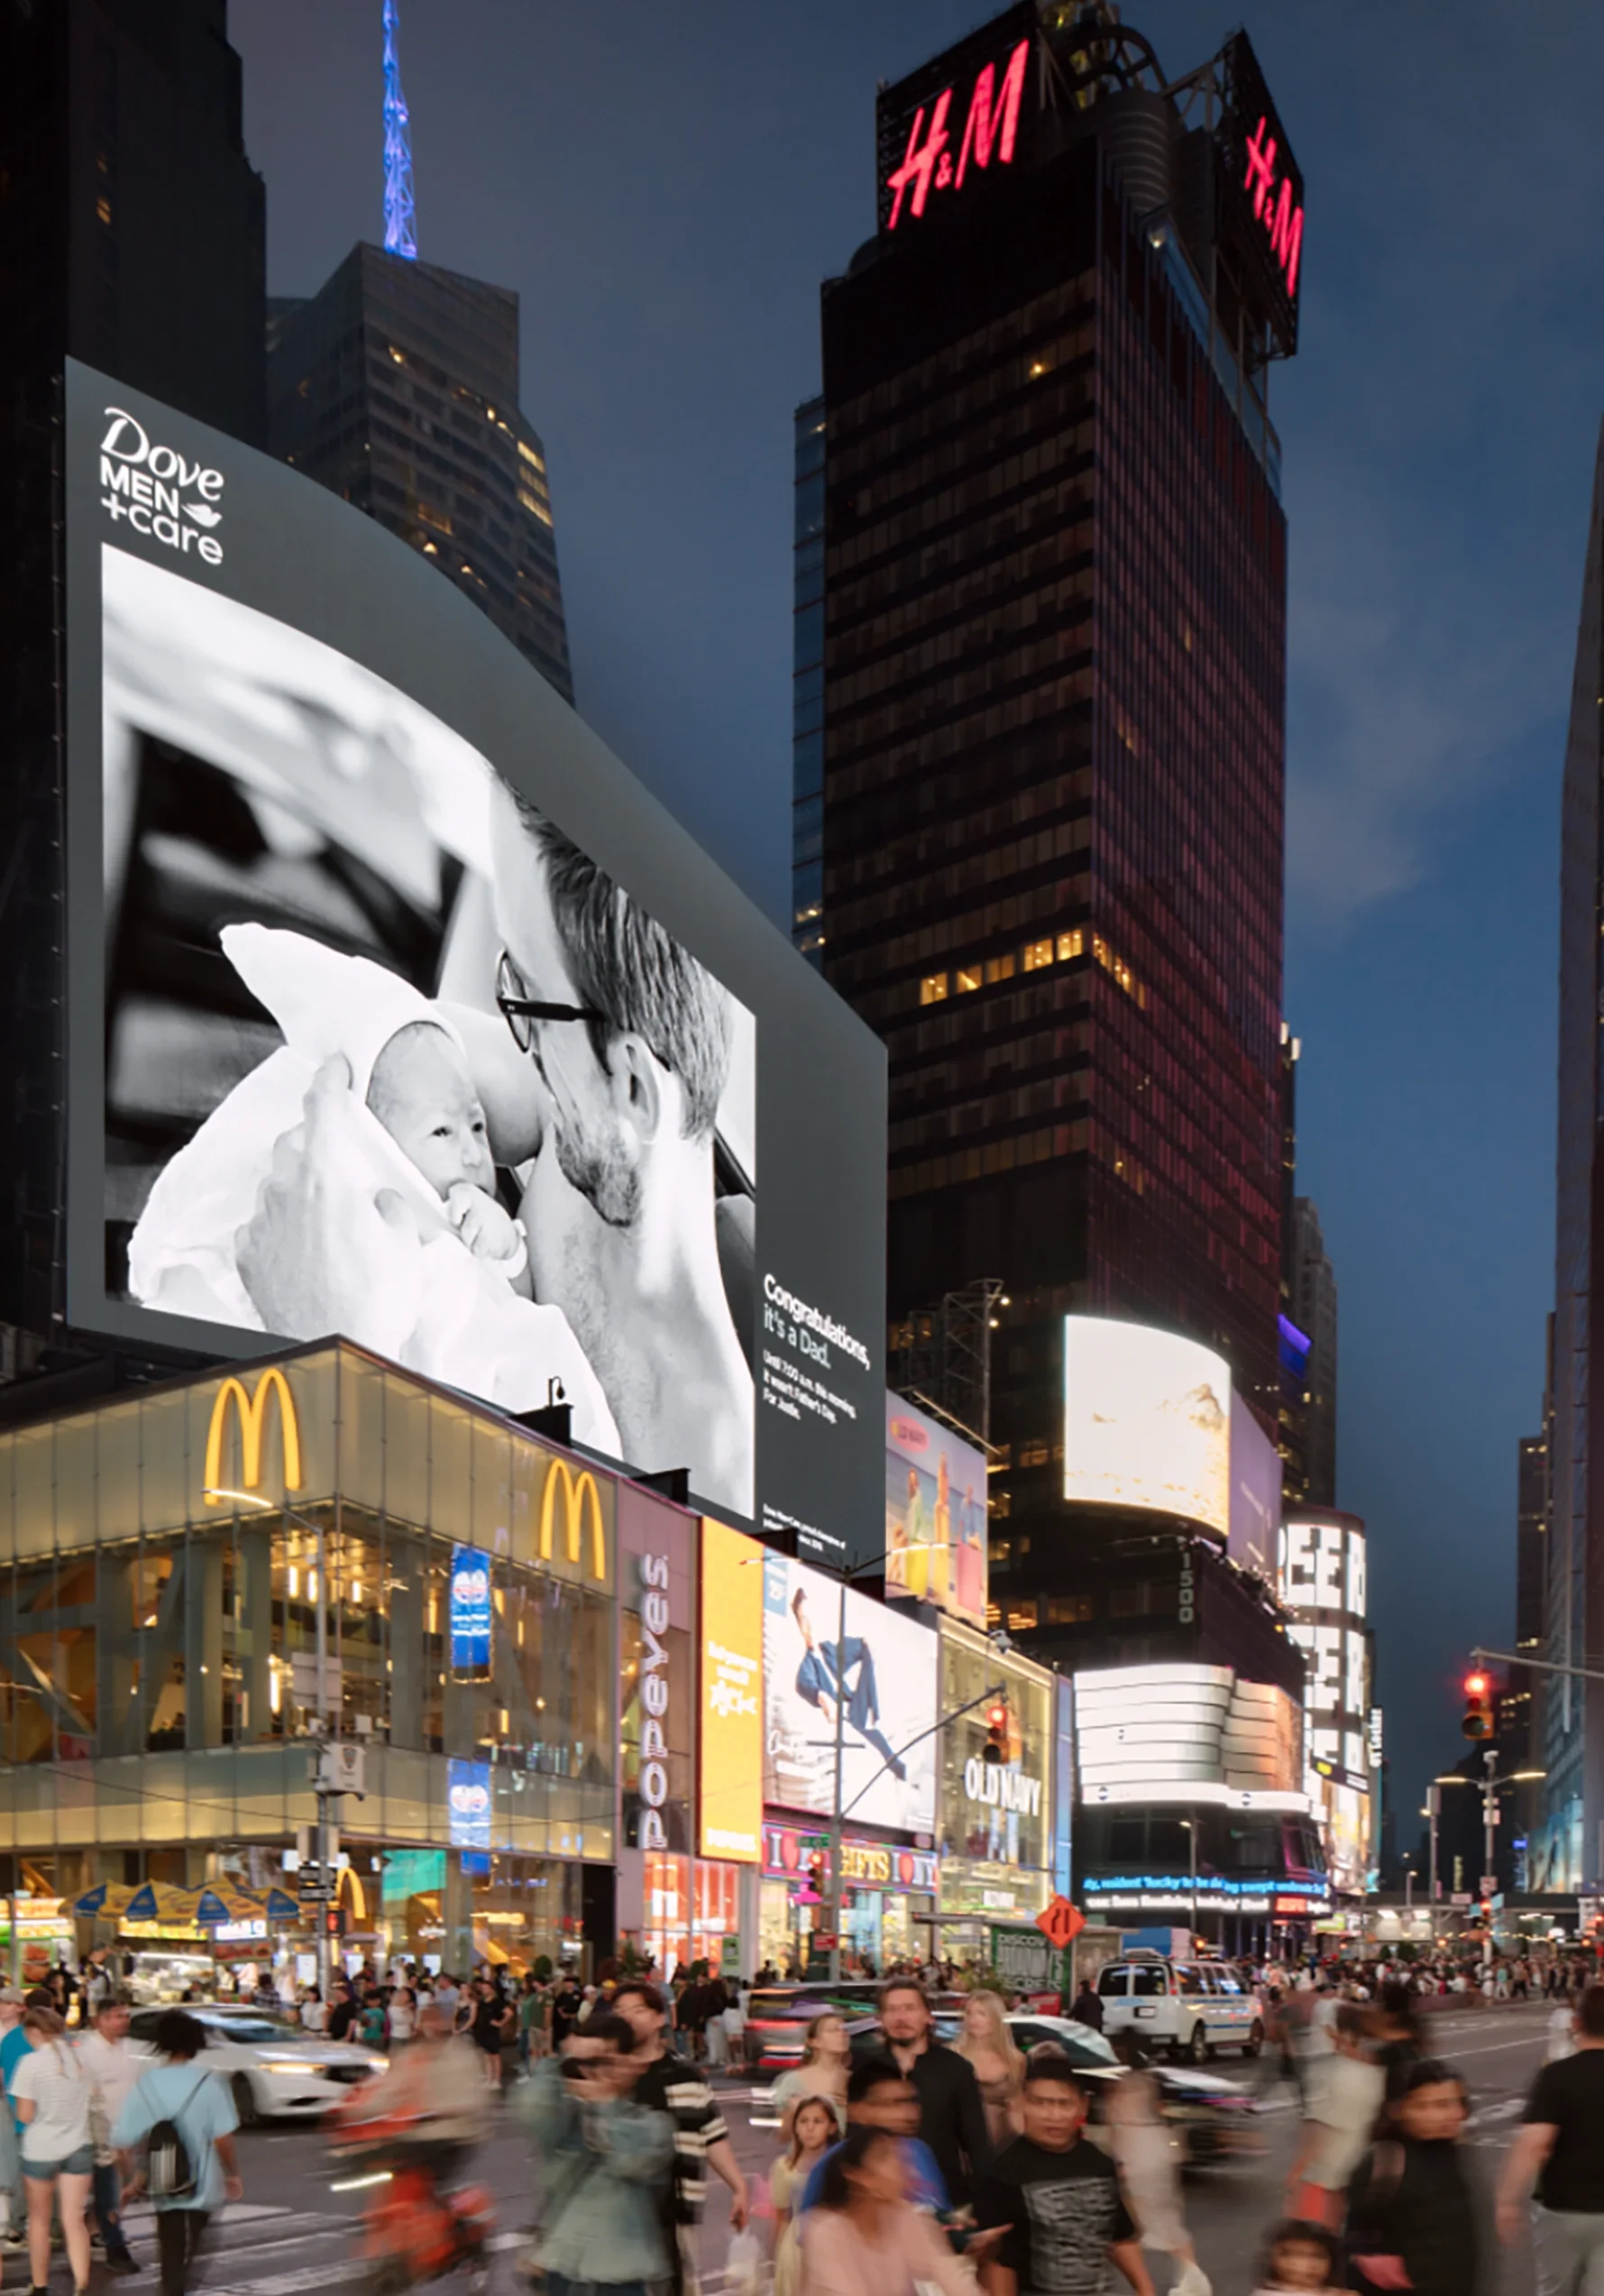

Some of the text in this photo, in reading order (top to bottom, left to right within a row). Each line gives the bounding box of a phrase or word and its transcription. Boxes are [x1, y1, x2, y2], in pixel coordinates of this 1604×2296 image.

[887, 38, 1030, 231] H&M
[1244, 115, 1305, 298] H&M
[101, 407, 224, 501] Dove
[101, 455, 179, 519] MEN
[101, 492, 224, 565] +care
[1178, 1551, 1196, 1623] 1500
[965, 1758, 1041, 1817] OLD NAVY
[997, 1933, 1048, 1947] DISCOV
